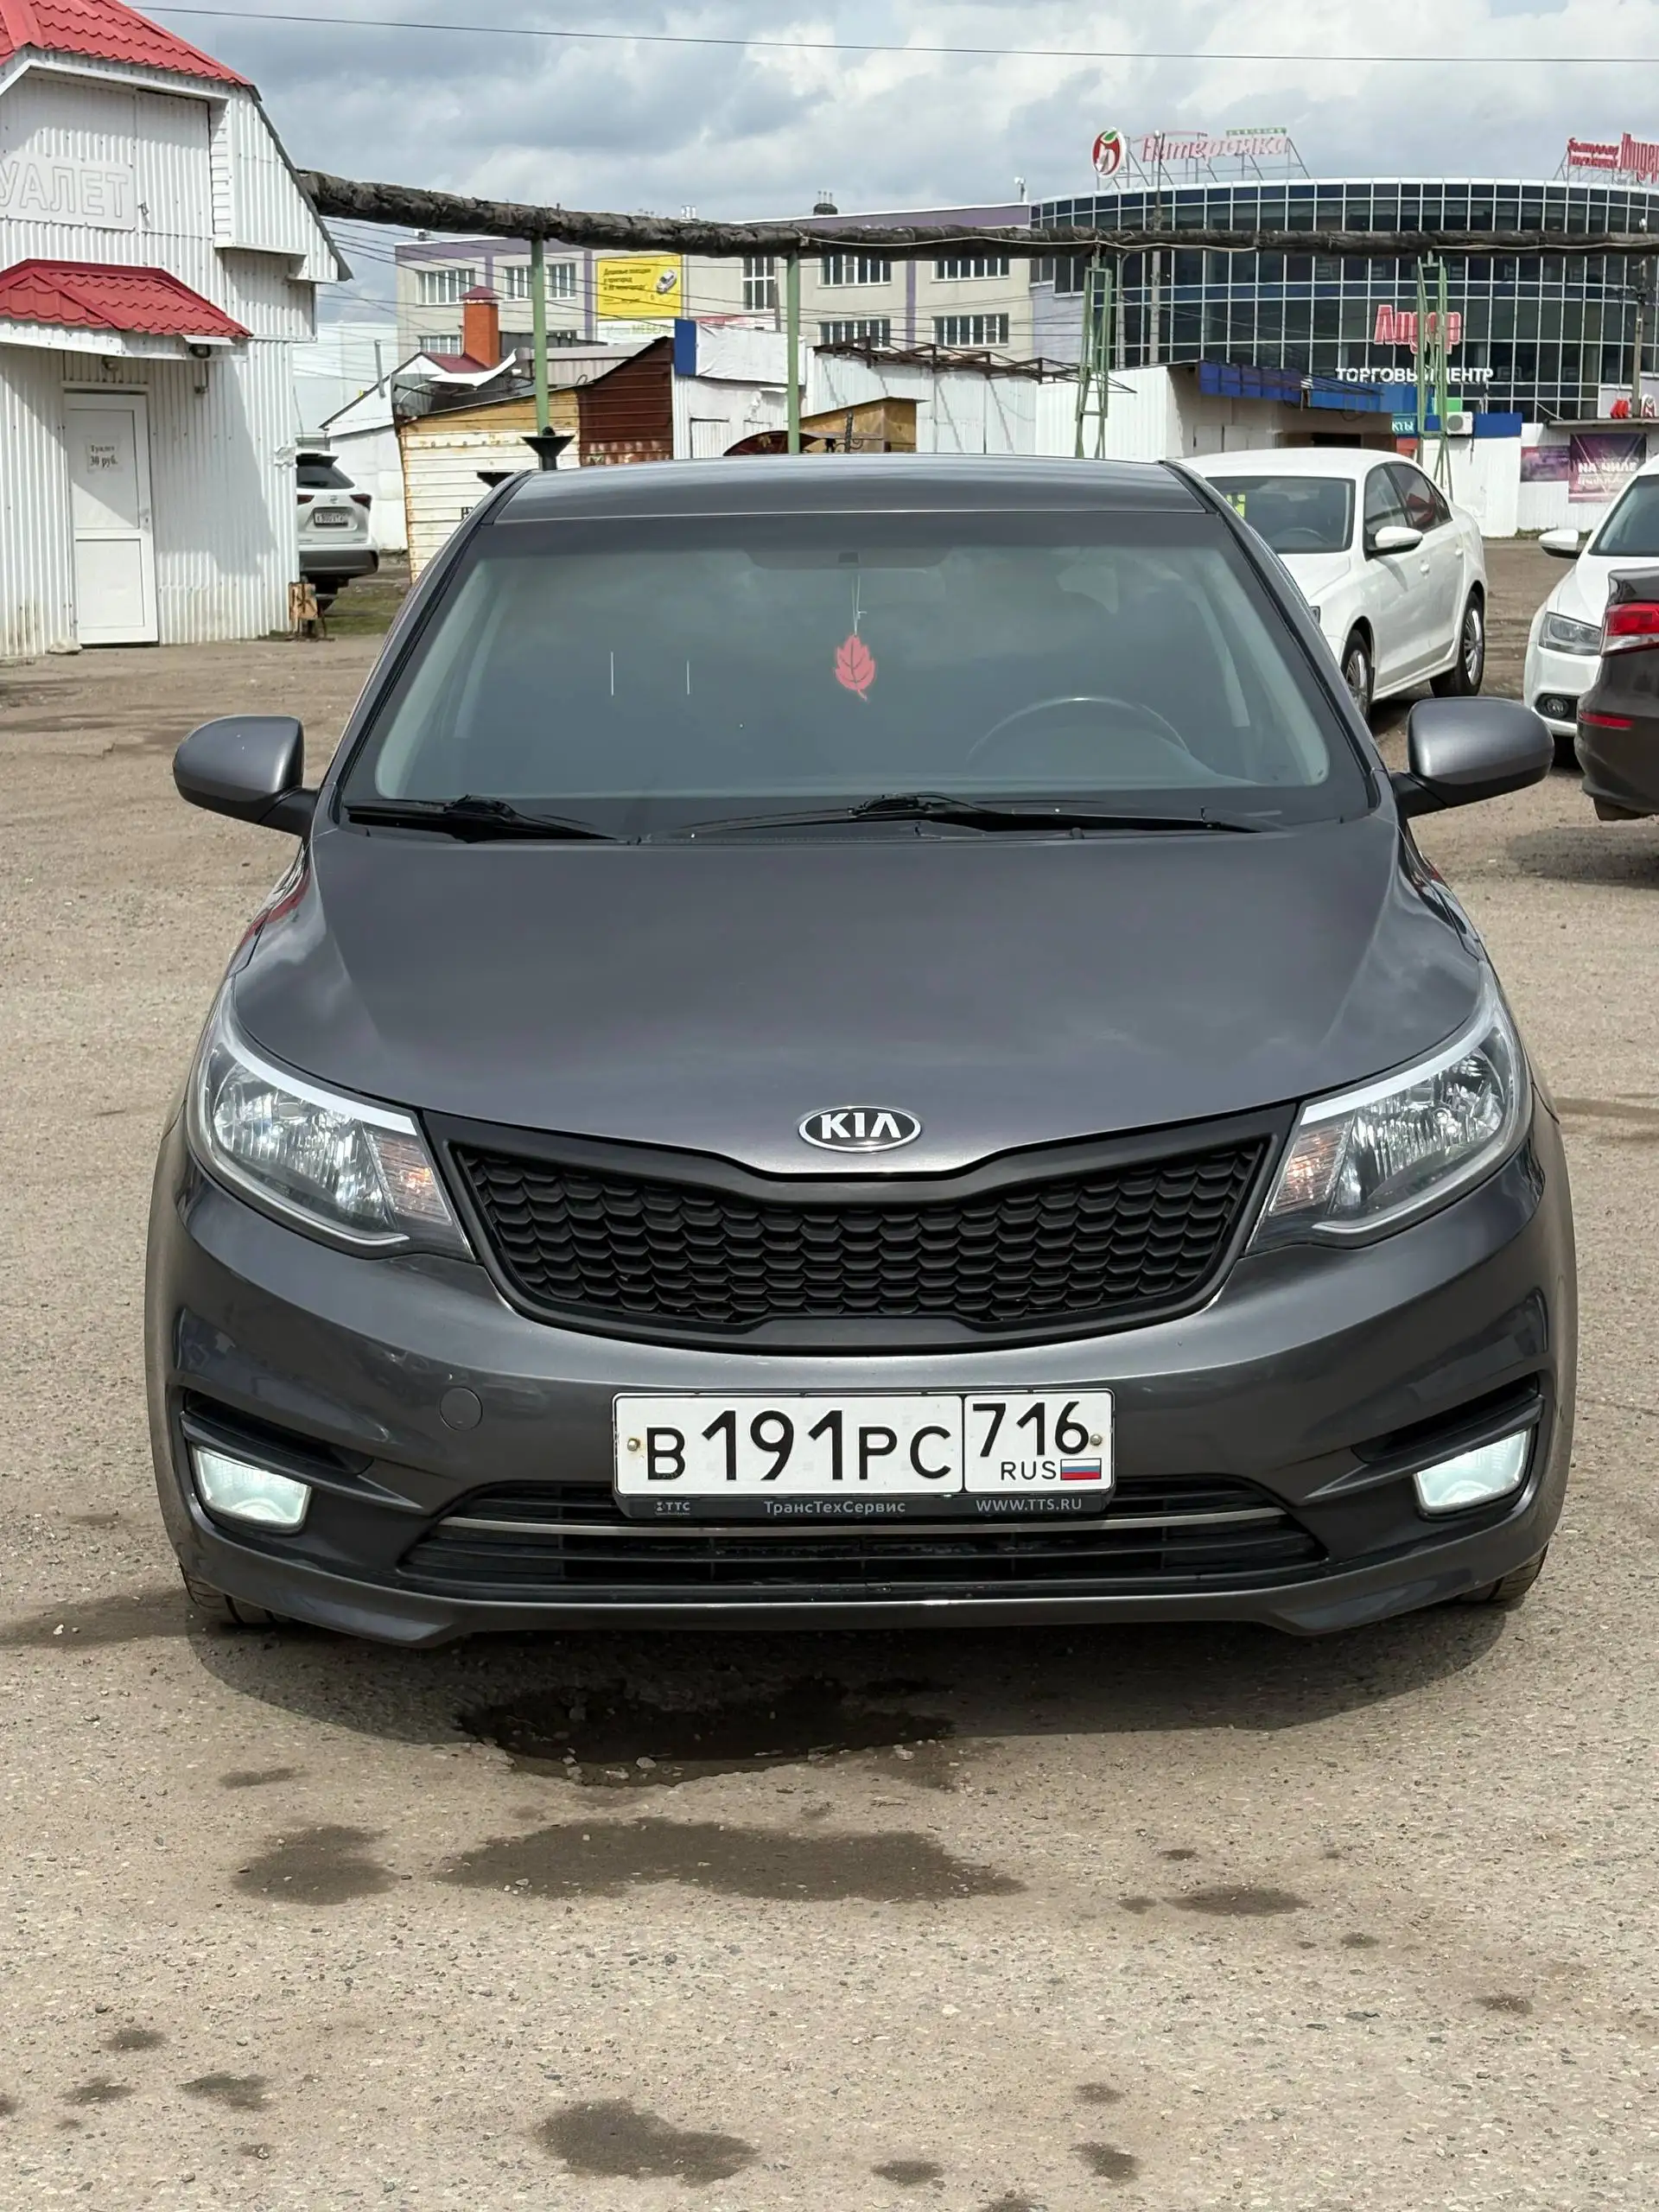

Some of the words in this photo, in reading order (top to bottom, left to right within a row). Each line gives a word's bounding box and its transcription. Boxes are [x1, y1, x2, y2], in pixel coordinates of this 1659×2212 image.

[1621, 131, 1659, 184] Лиде
[1443, 367, 1494, 385] ЕНТР
[820, 1112, 902, 1140] KIA
[972, 1401, 1090, 1458] 716
[1001, 1460, 1058, 1481] RUS
[764, 1501, 906, 1516] ТрансТехСервис
[976, 1497, 1082, 1512] WWW.TTS.RU
